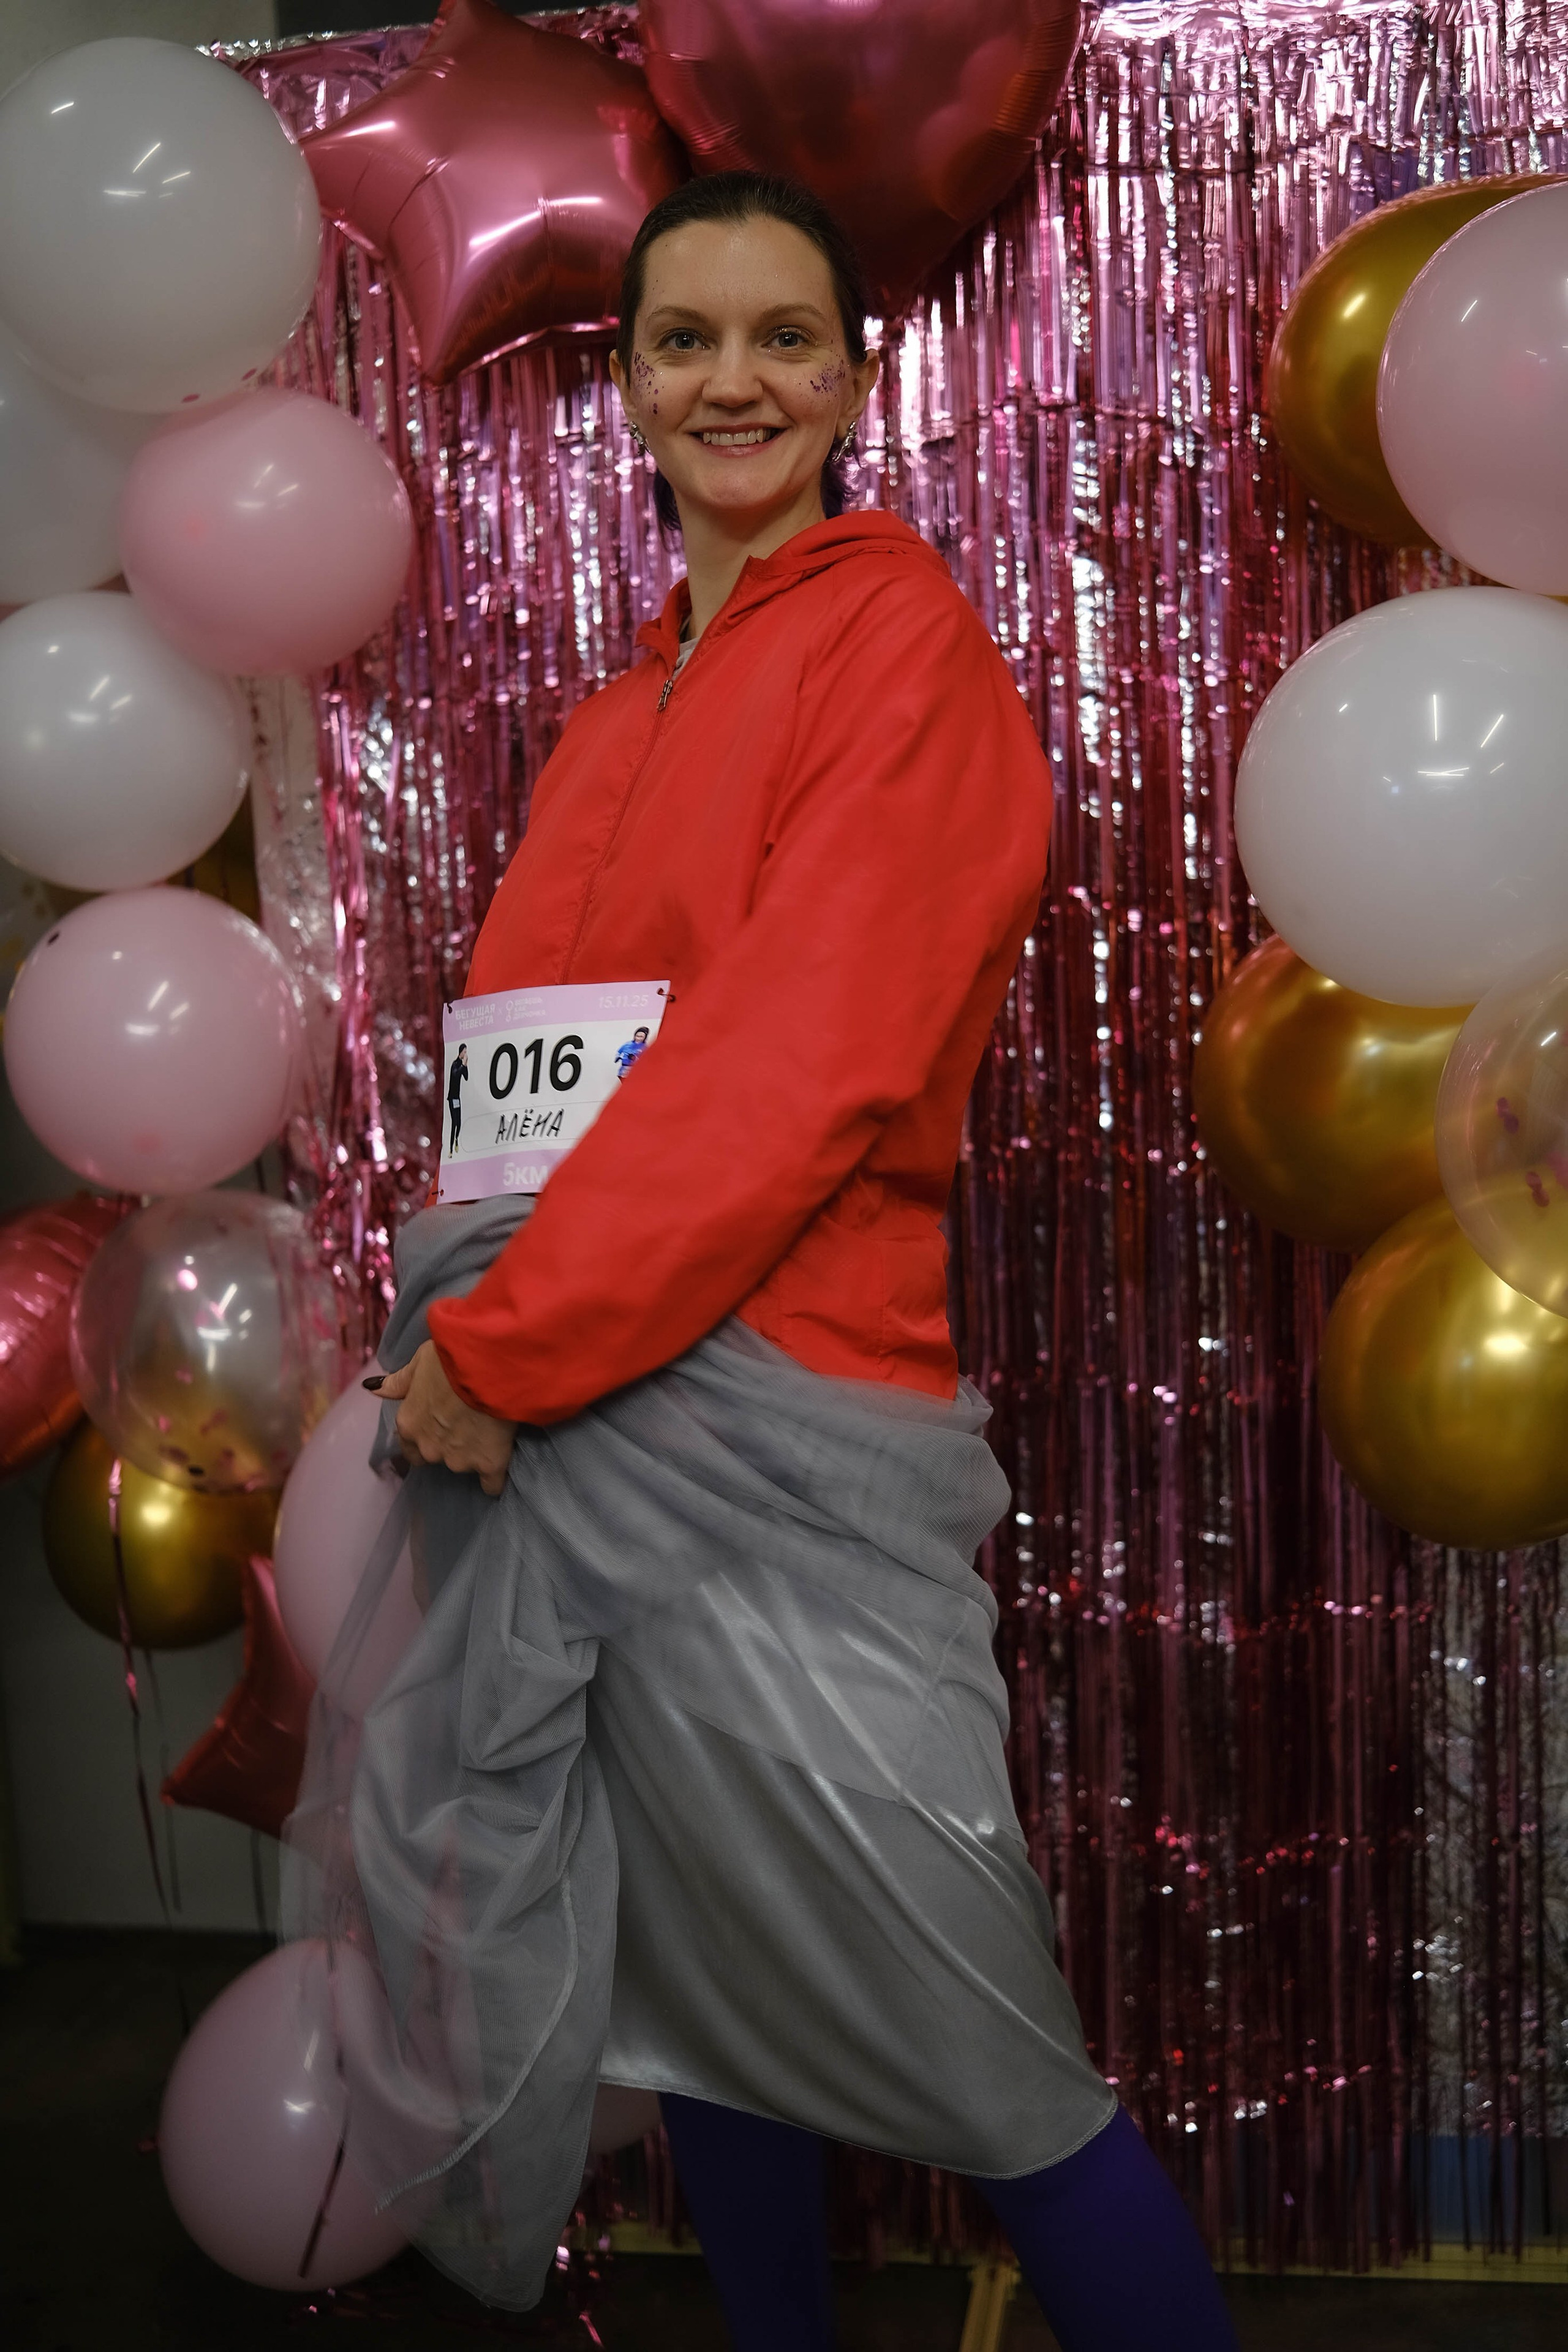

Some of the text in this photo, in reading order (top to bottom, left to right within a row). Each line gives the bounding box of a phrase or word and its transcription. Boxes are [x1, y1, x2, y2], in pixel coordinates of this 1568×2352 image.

[598, 994, 649, 1009] 15.11.25
[455, 1003, 495, 1020] БЕГУЩАЯ
[459, 1015, 494, 1031] НЕВЕСТА
[489, 1035, 584, 1101] 016
[495, 1108, 565, 1144] АЛЁНА
